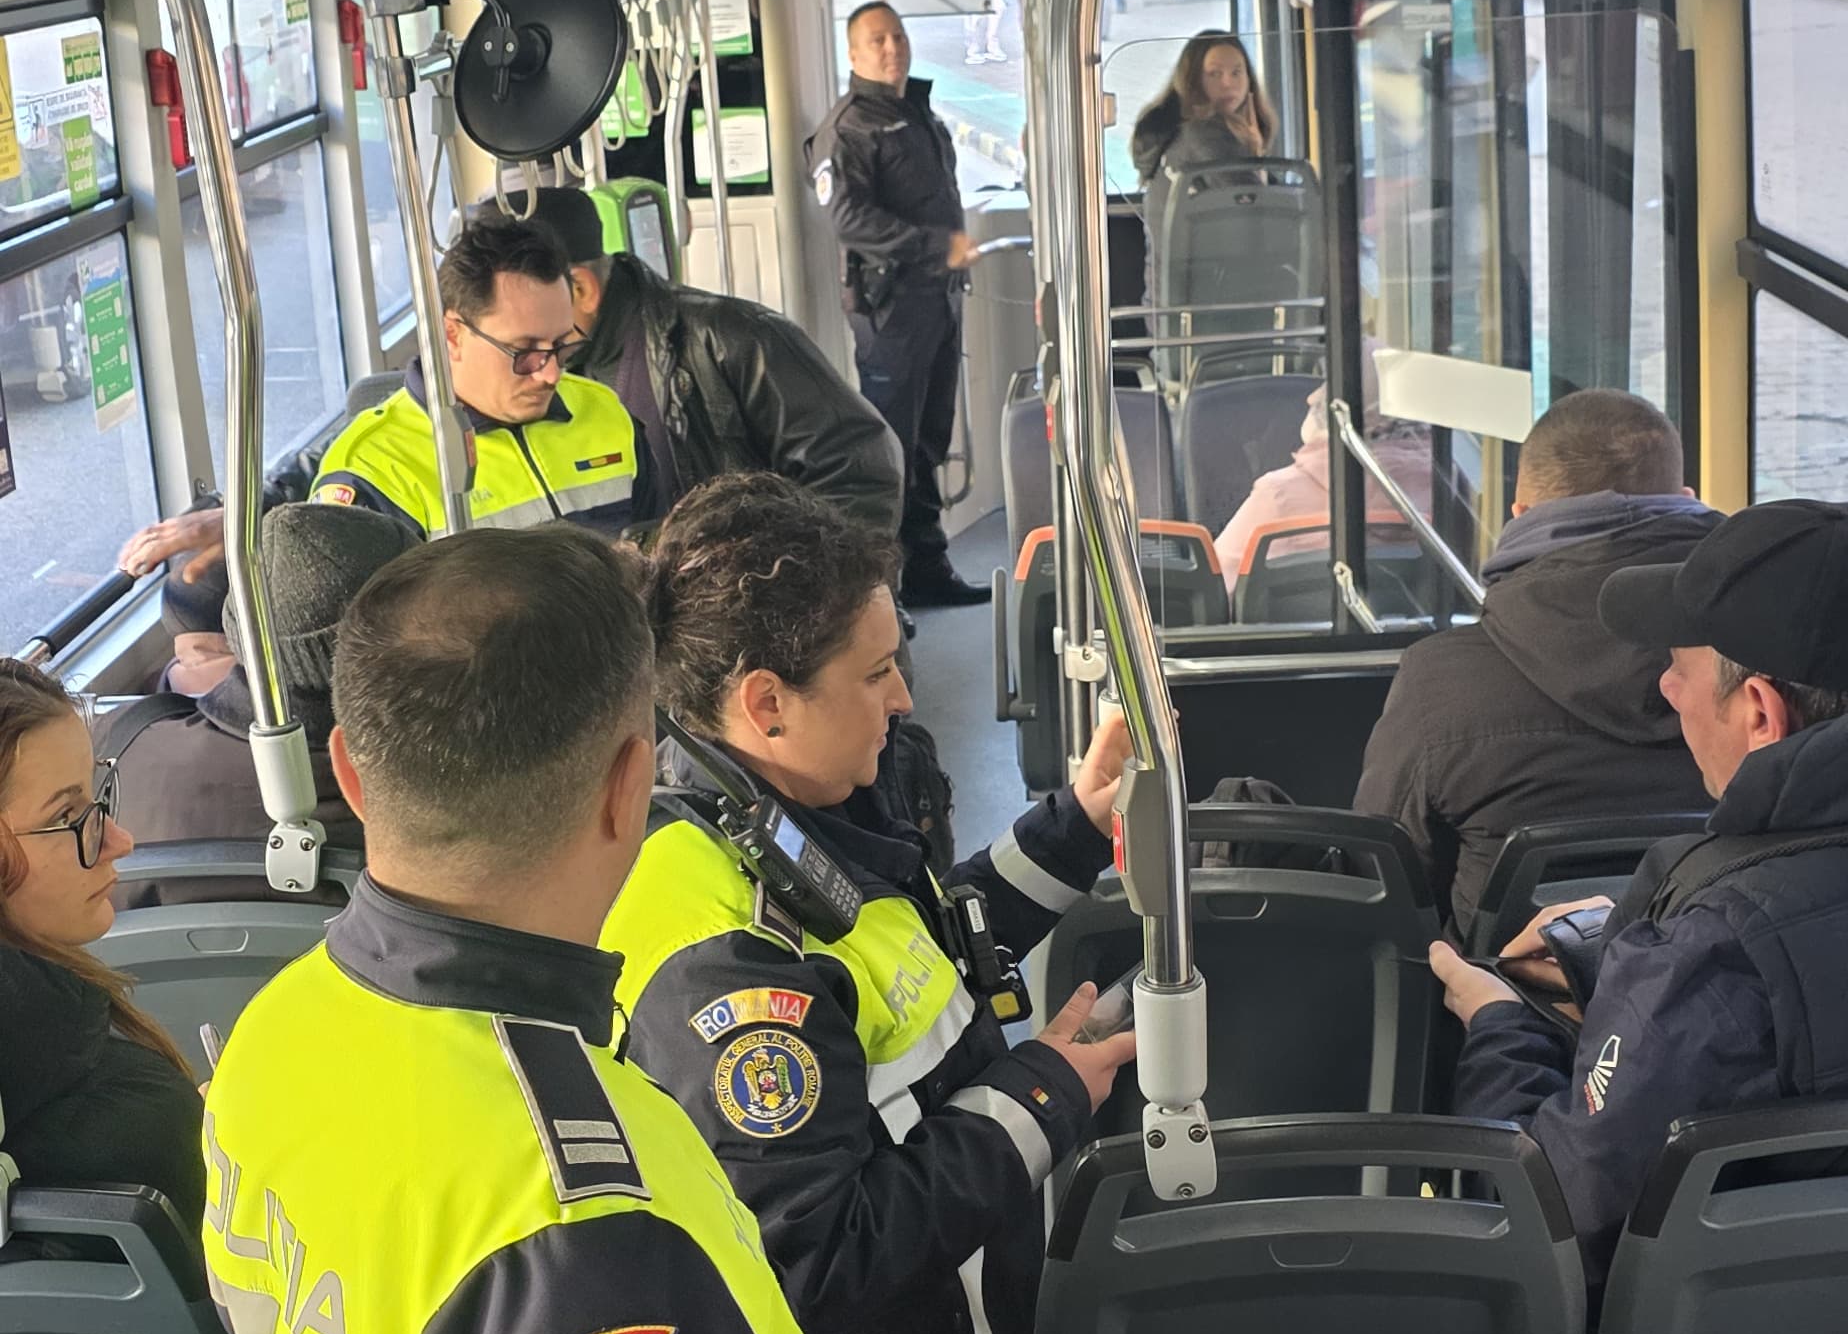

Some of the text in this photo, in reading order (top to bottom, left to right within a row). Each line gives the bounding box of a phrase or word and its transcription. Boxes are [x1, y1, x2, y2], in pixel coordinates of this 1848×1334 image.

[885, 930, 941, 1024] POLITI
[696, 995, 801, 1037] ROMANIA
[731, 1033, 770, 1056] GENERAL
[771, 1033, 783, 1043] AL
